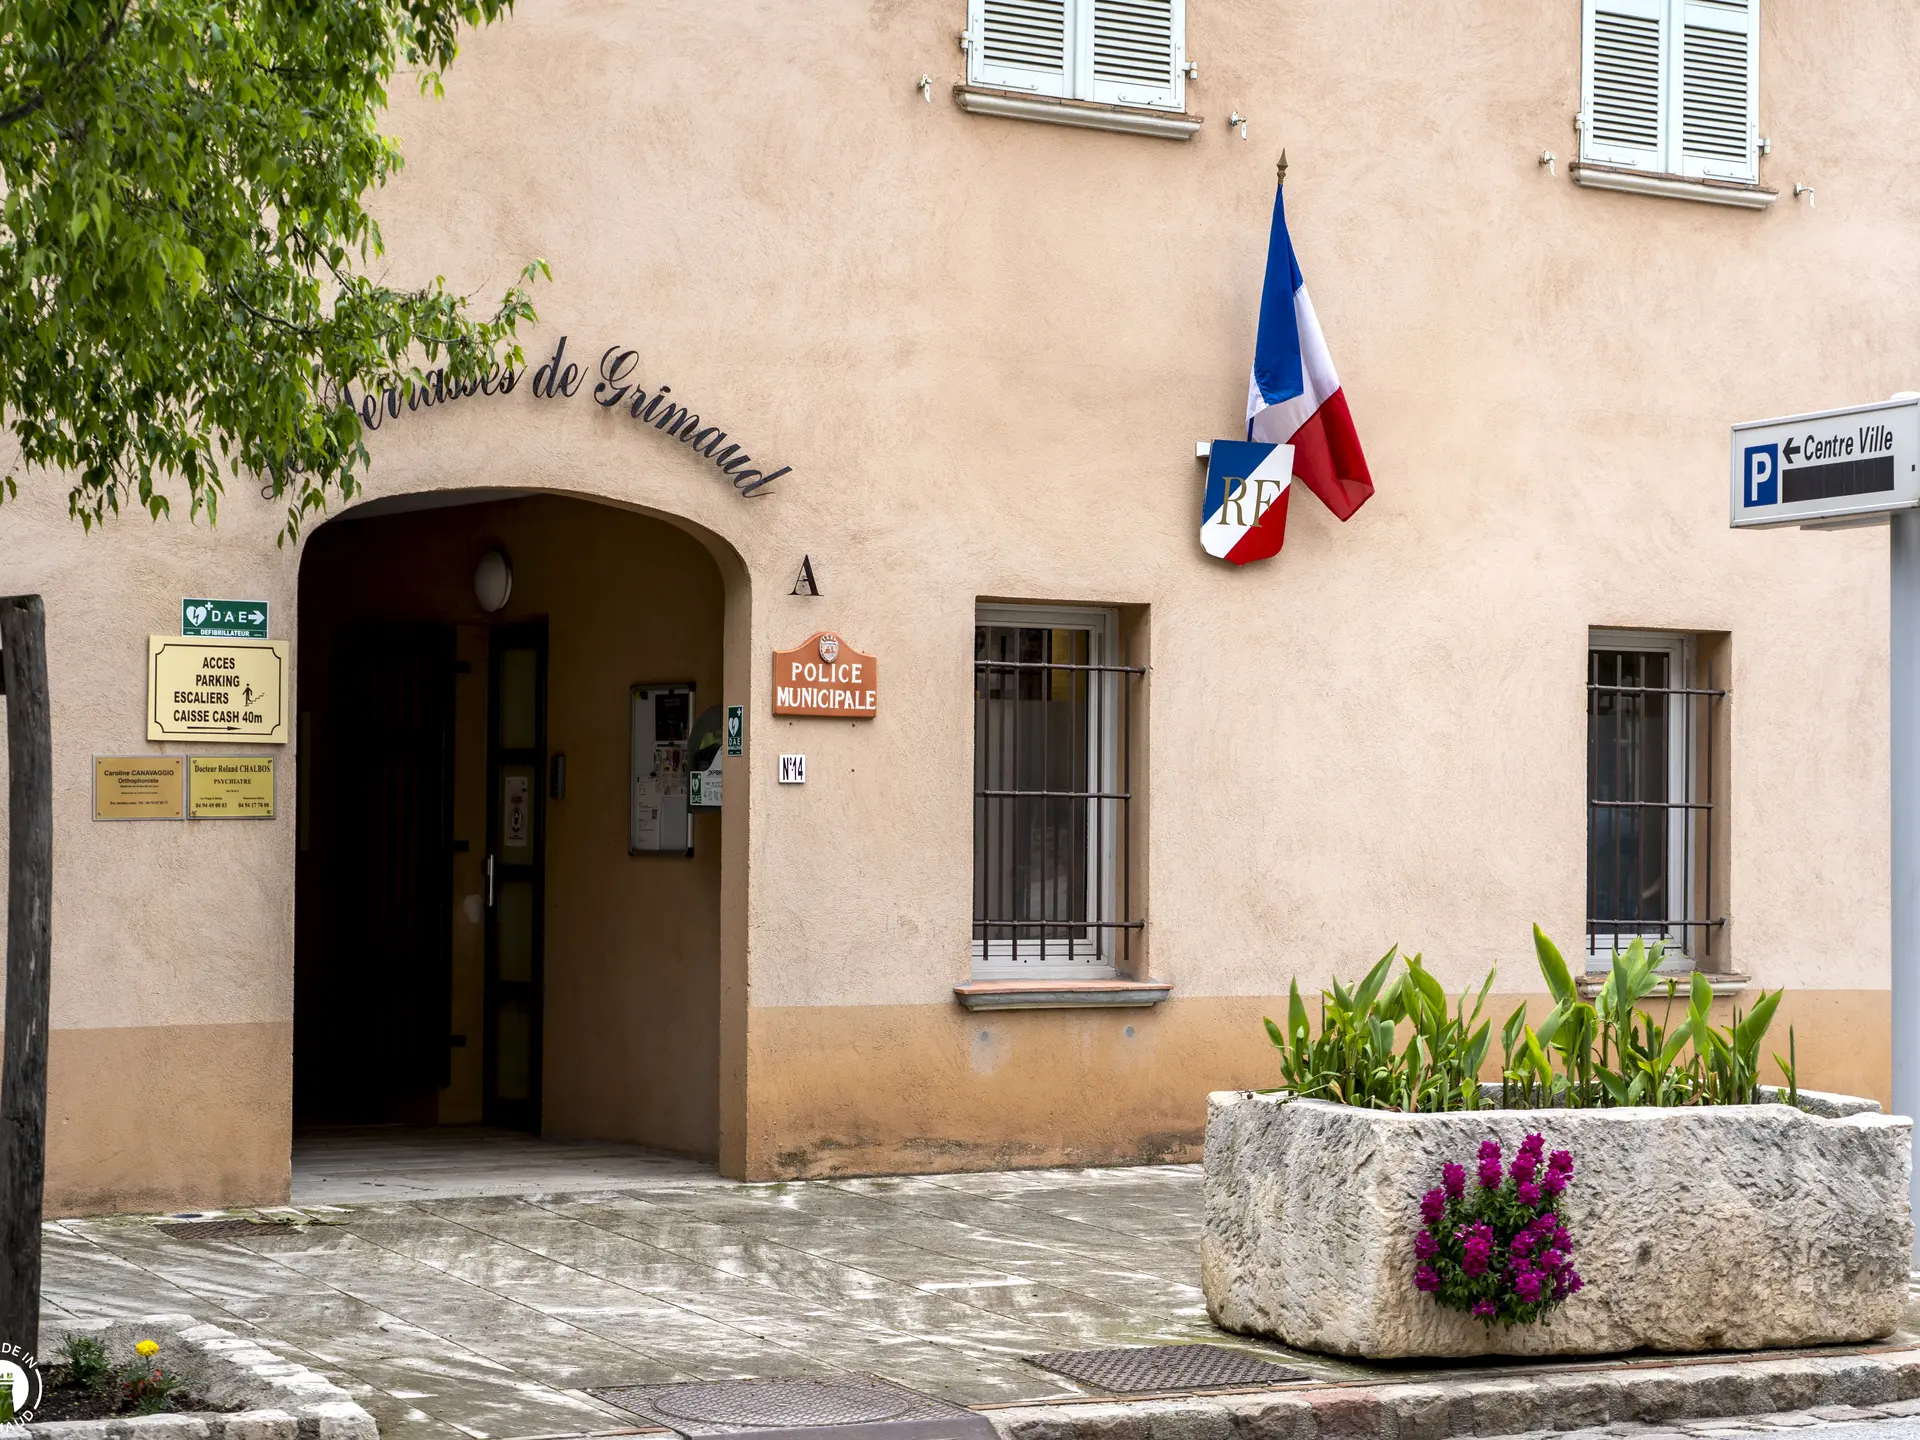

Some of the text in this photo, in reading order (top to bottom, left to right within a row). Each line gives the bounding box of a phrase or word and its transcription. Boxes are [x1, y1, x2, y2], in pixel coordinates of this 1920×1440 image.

[533, 336, 589, 399] de
[593, 345, 793, 499] Grimaud
[1804, 425, 1893, 461] Centre Ville
[1751, 452, 1772, 502] P
[1216, 476, 1281, 528] RF
[787, 554, 824, 597] A
[211, 610, 247, 623] DAE
[202, 657, 236, 670] ACCES
[792, 662, 862, 684] POLICE
[195, 674, 240, 687] PARKING
[174, 691, 229, 704] ESCALIERS
[777, 686, 876, 710] MUNICIPALE
[173, 709, 263, 724] CAISSE CASH 40m
[194, 764, 217, 773] Docteur
[239, 764, 271, 773] CHALBOS
